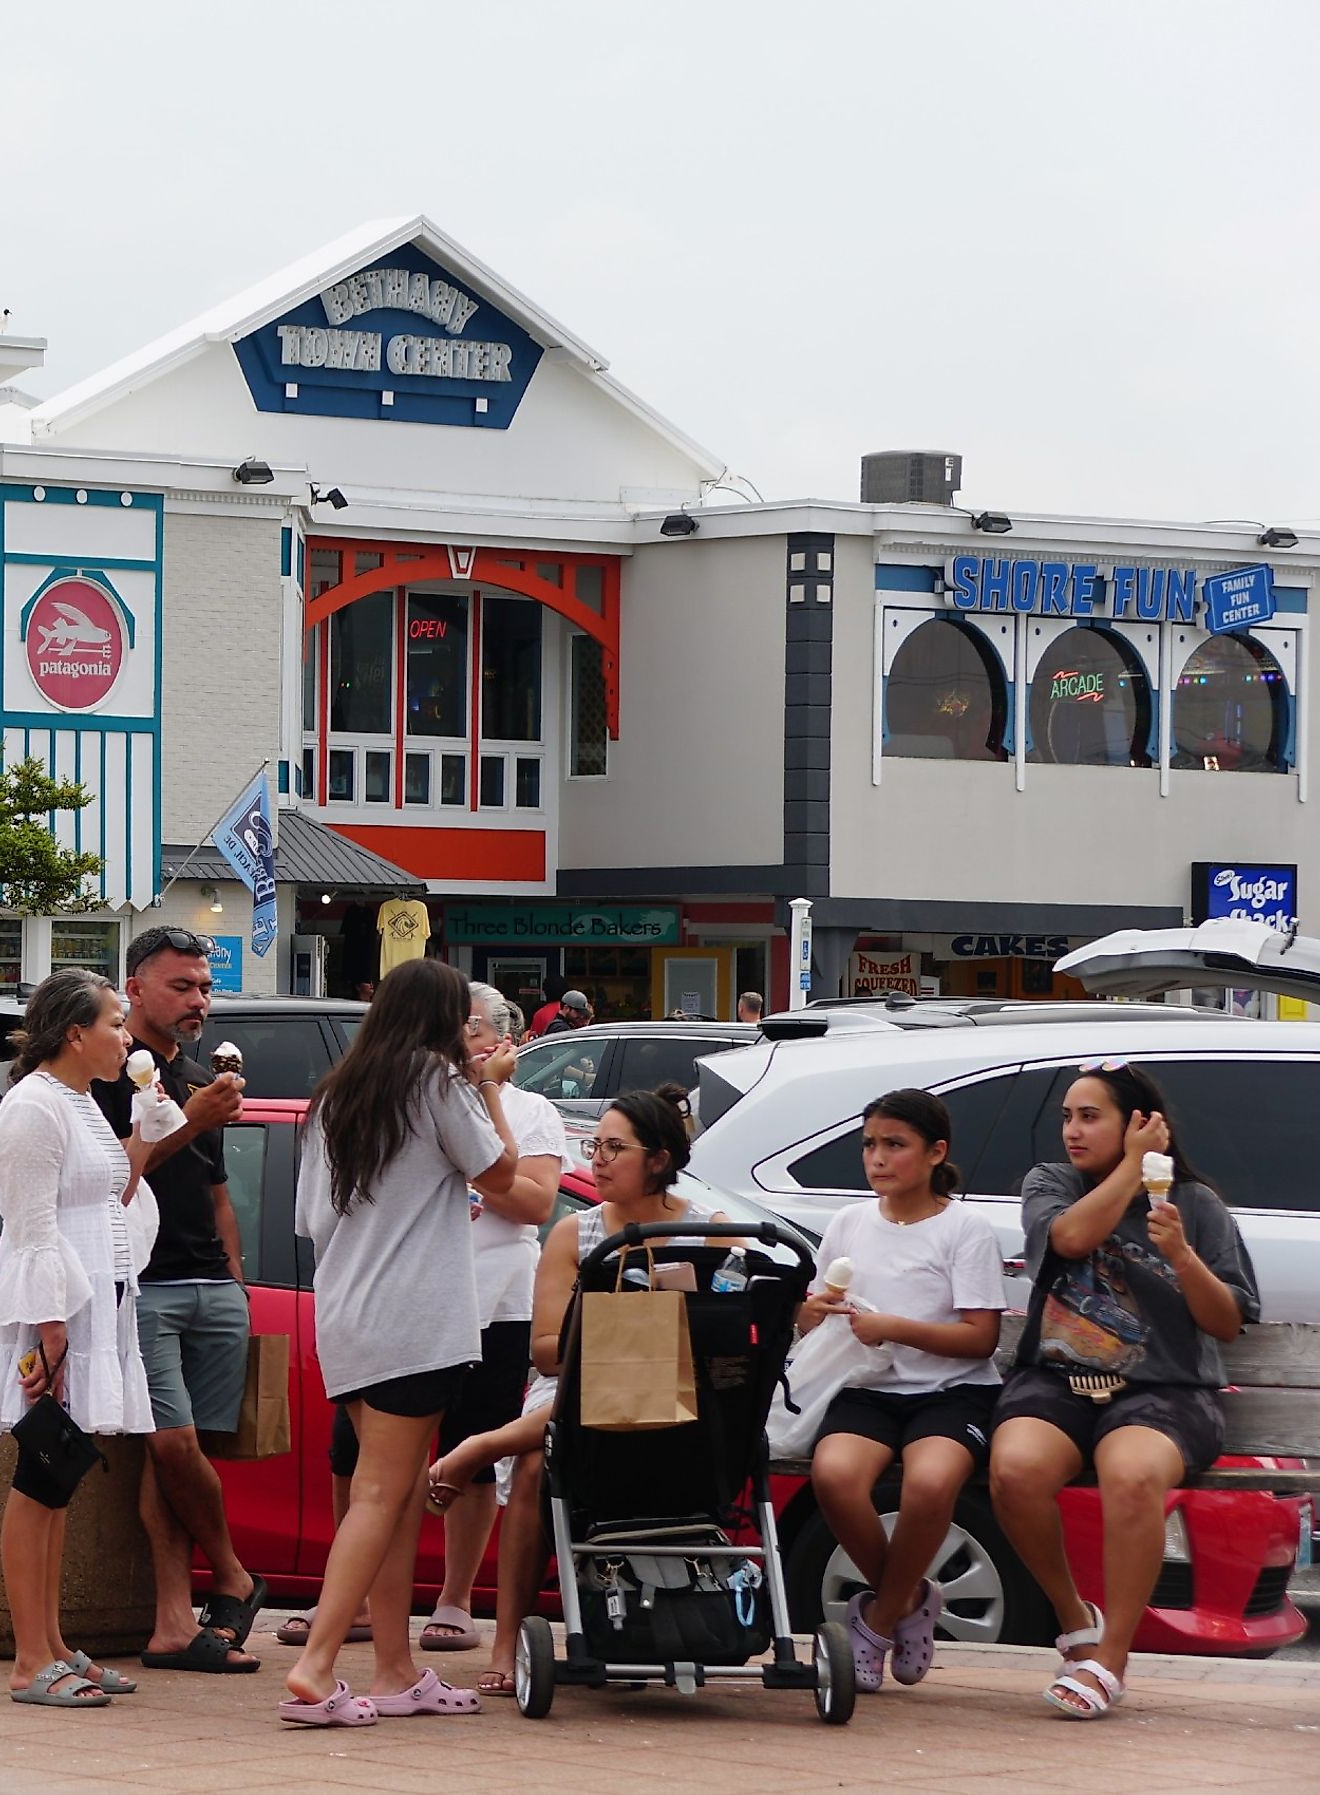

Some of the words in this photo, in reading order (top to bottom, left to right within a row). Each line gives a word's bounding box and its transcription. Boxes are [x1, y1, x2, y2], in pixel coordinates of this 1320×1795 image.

[320, 269, 479, 334] BETHANY
[277, 325, 382, 371] TOWN
[387, 334, 512, 382] CENTER
[949, 555, 1098, 616] SHORE
[1110, 566, 1197, 621] FUN
[1222, 574, 1255, 594] FAMILY
[1230, 591, 1249, 606] FUN
[1222, 603, 1259, 624] CENTER
[409, 620, 447, 639] OPEN
[39, 660, 111, 678] patagonia
[1050, 673, 1103, 699] ARCADE
[1227, 875, 1288, 909] Sugar
[449, 912, 508, 936] Three
[514, 912, 584, 936] Blonde
[591, 913, 662, 936] Bakers
[951, 935, 1069, 957] CAKES
[858, 953, 911, 974] FRESH
